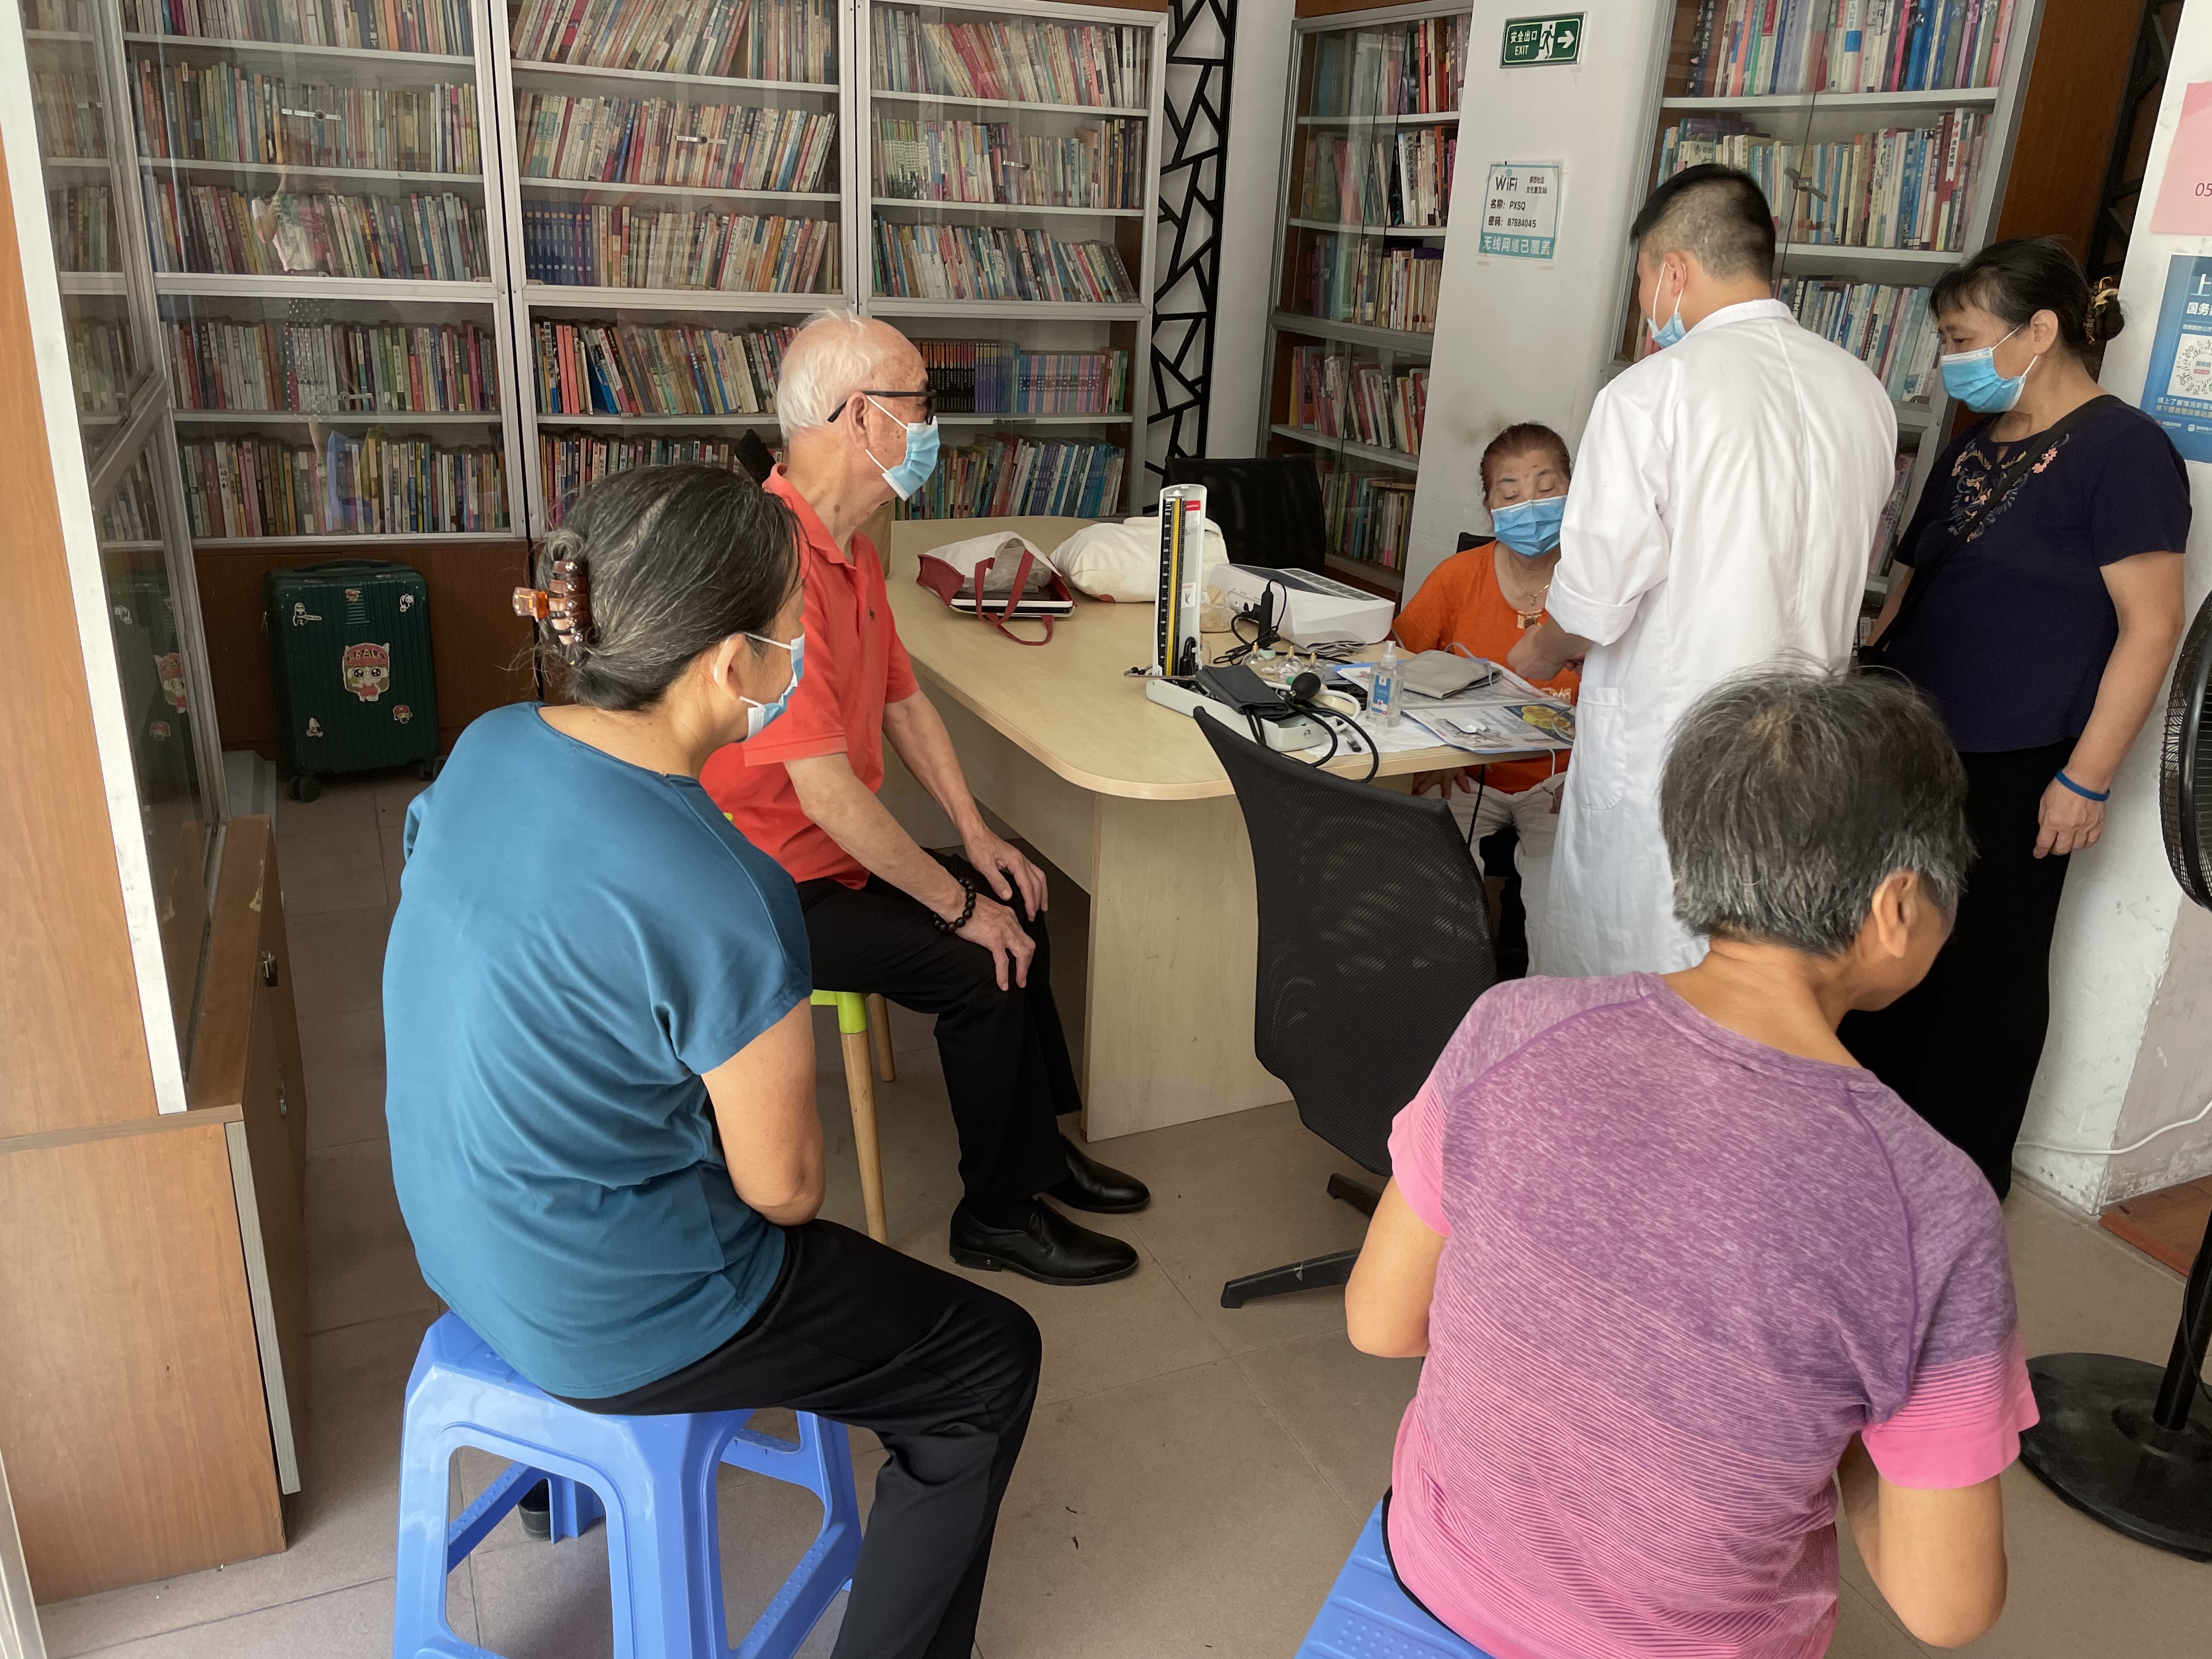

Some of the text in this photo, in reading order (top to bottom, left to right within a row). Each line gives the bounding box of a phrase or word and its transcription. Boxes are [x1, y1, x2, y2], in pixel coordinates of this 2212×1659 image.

[1510, 30, 1538, 43] 安全出口
[1515, 45, 1529, 55] EXIT
[1496, 177, 1518, 191] WiFi
[1509, 201, 1526, 211] PXSQ
[1483, 236, 1551, 255] 无线网络已覆盖
[2190, 273, 2212, 297] 上
[2186, 302, 2212, 317] 国务
